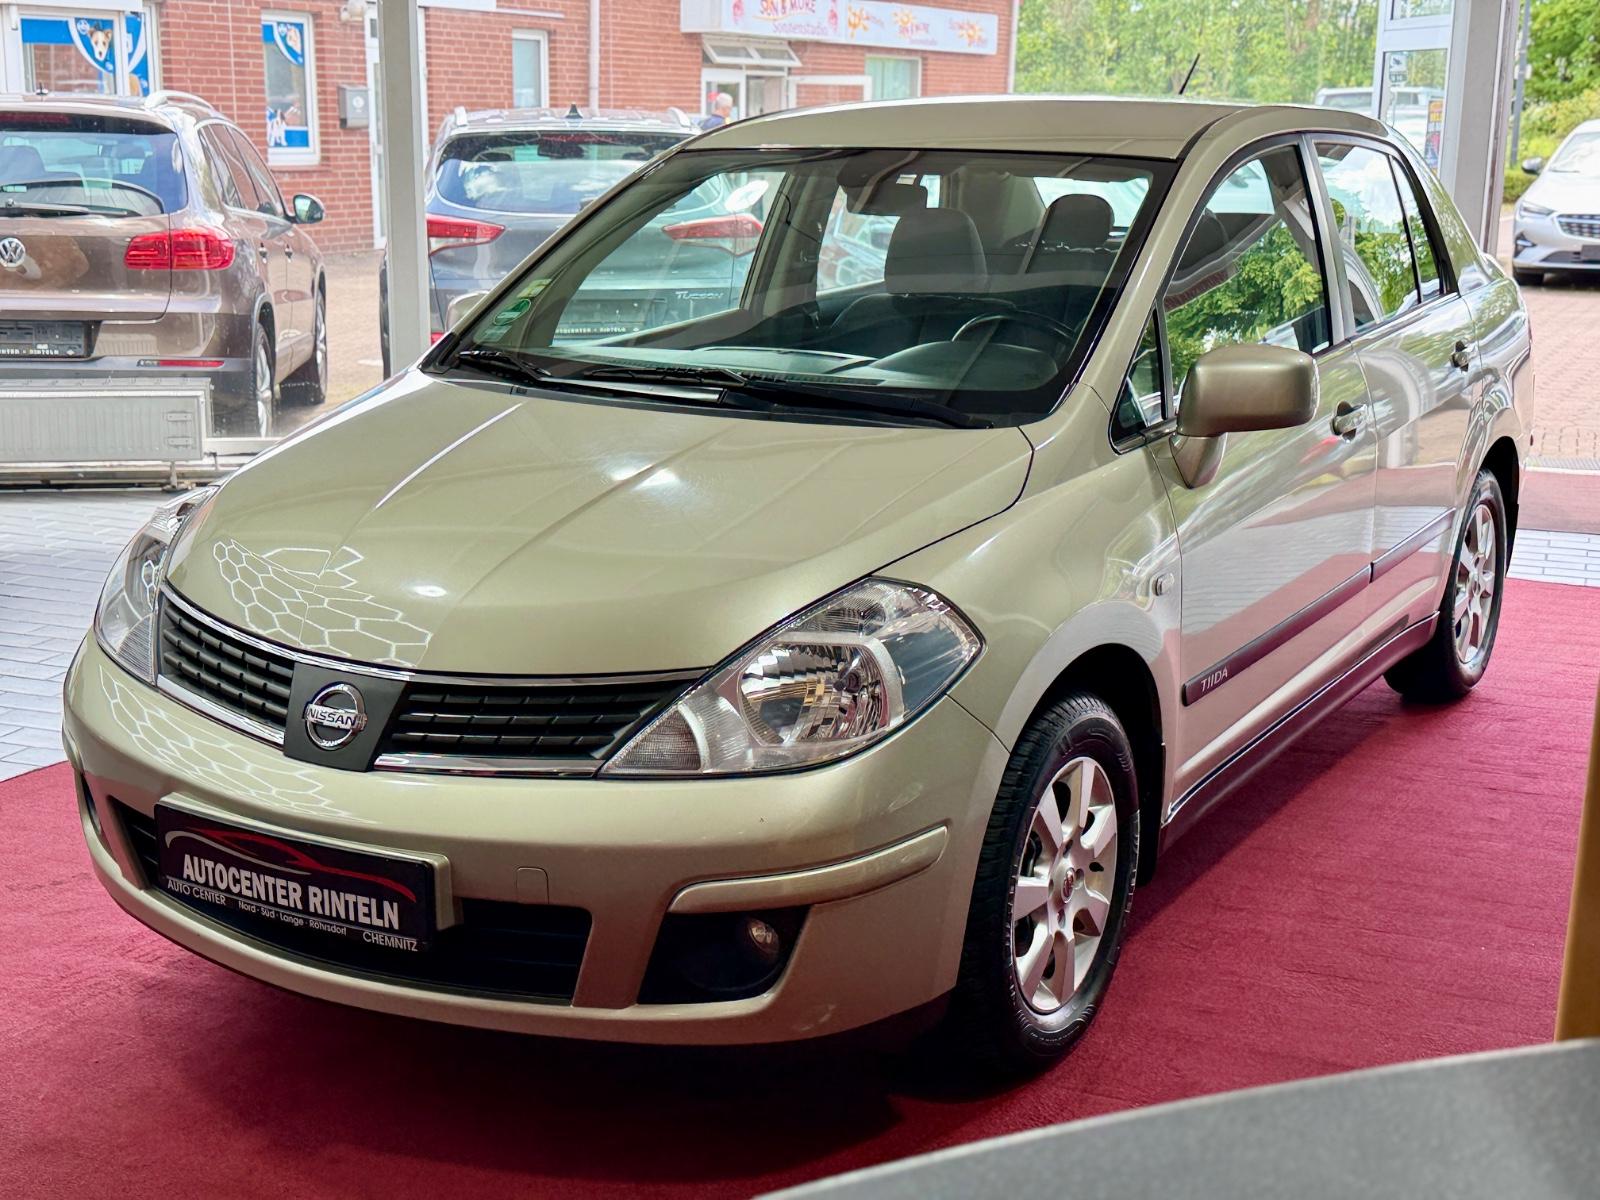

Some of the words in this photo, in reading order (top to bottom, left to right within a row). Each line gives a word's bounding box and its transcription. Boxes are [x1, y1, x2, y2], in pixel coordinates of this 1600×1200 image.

[1201, 666, 1228, 692] TIIDA
[308, 708, 358, 727] NISSAN
[167, 879, 191, 895] AUTO
[192, 887, 227, 906] CENTER
[183, 853, 303, 910] AUTOCENTER
[307, 885, 400, 930] RINTELN
[238, 900, 257, 913] Nord
[260, 905, 275, 919] Süd
[280, 912, 304, 927] Lange
[362, 931, 418, 952] CHEMNITZ
